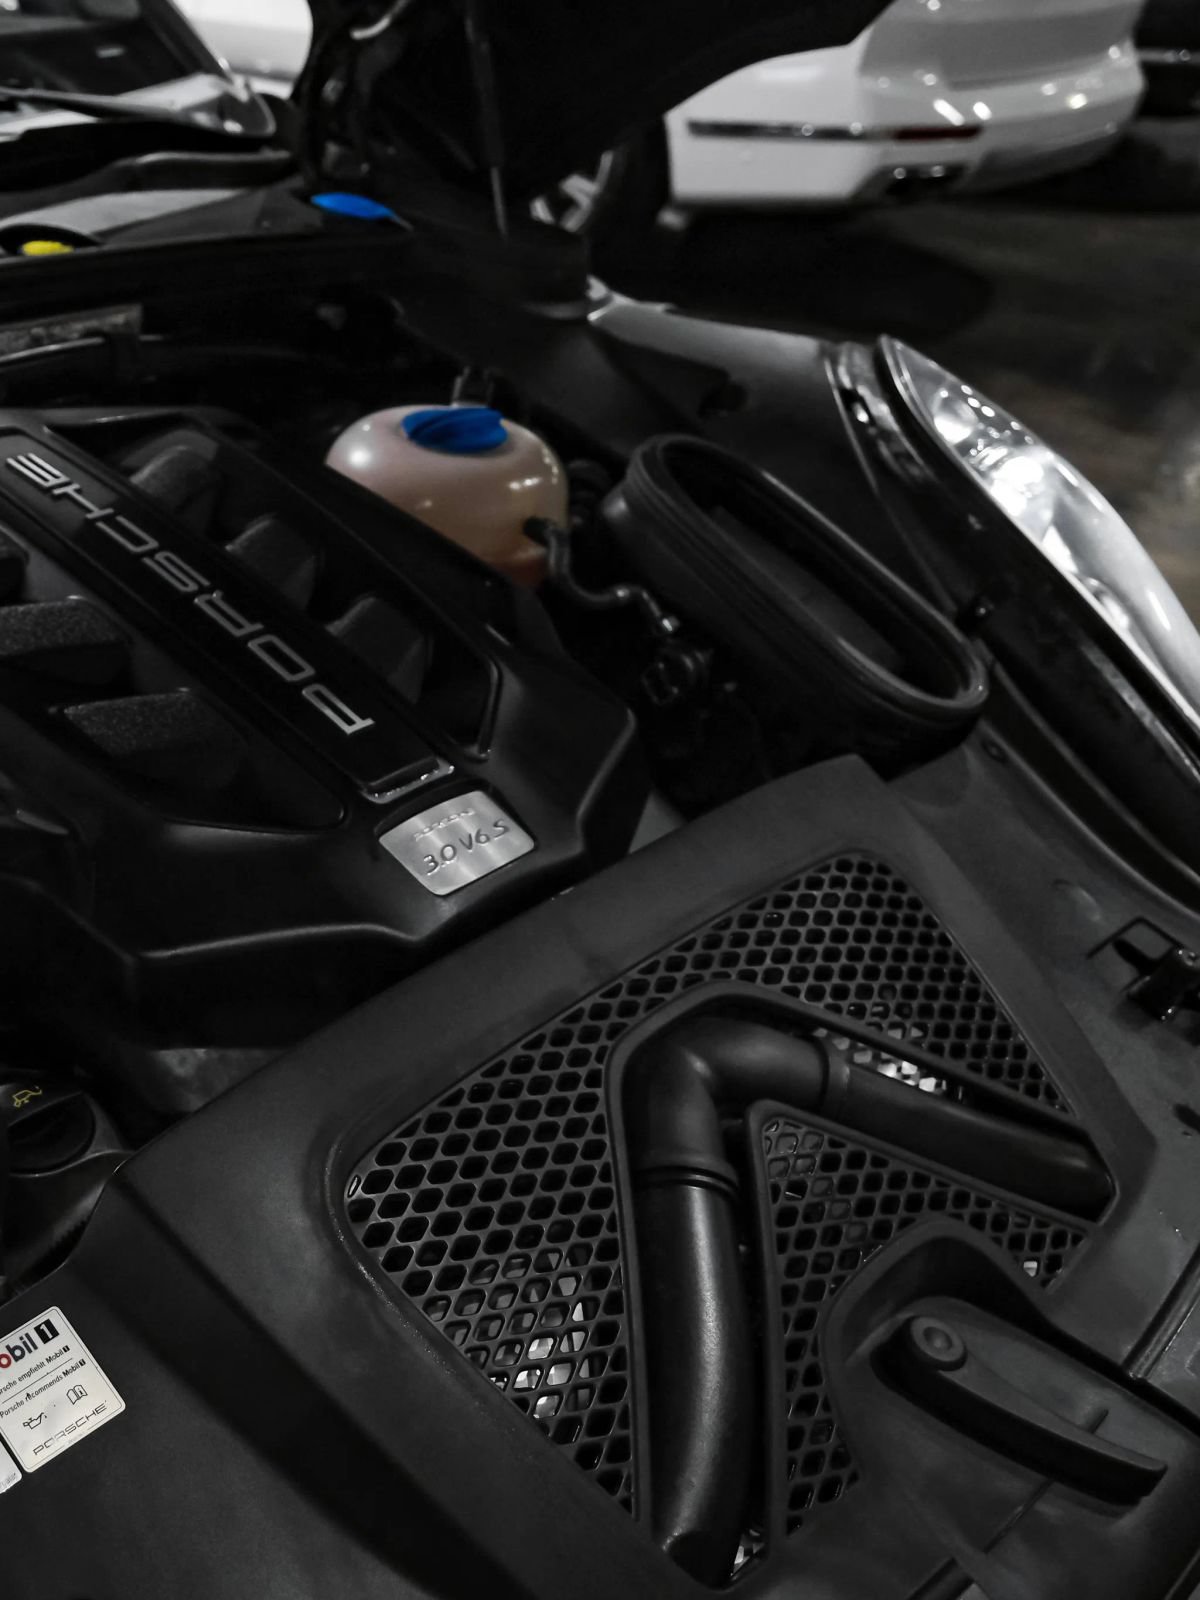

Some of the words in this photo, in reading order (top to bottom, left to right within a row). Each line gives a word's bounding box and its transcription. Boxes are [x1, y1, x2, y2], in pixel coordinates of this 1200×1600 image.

[6, 453, 375, 735] PORSCHE
[18, 1361, 46, 1383] empfiehlt
[0, 1400, 25, 1418] Porsche
